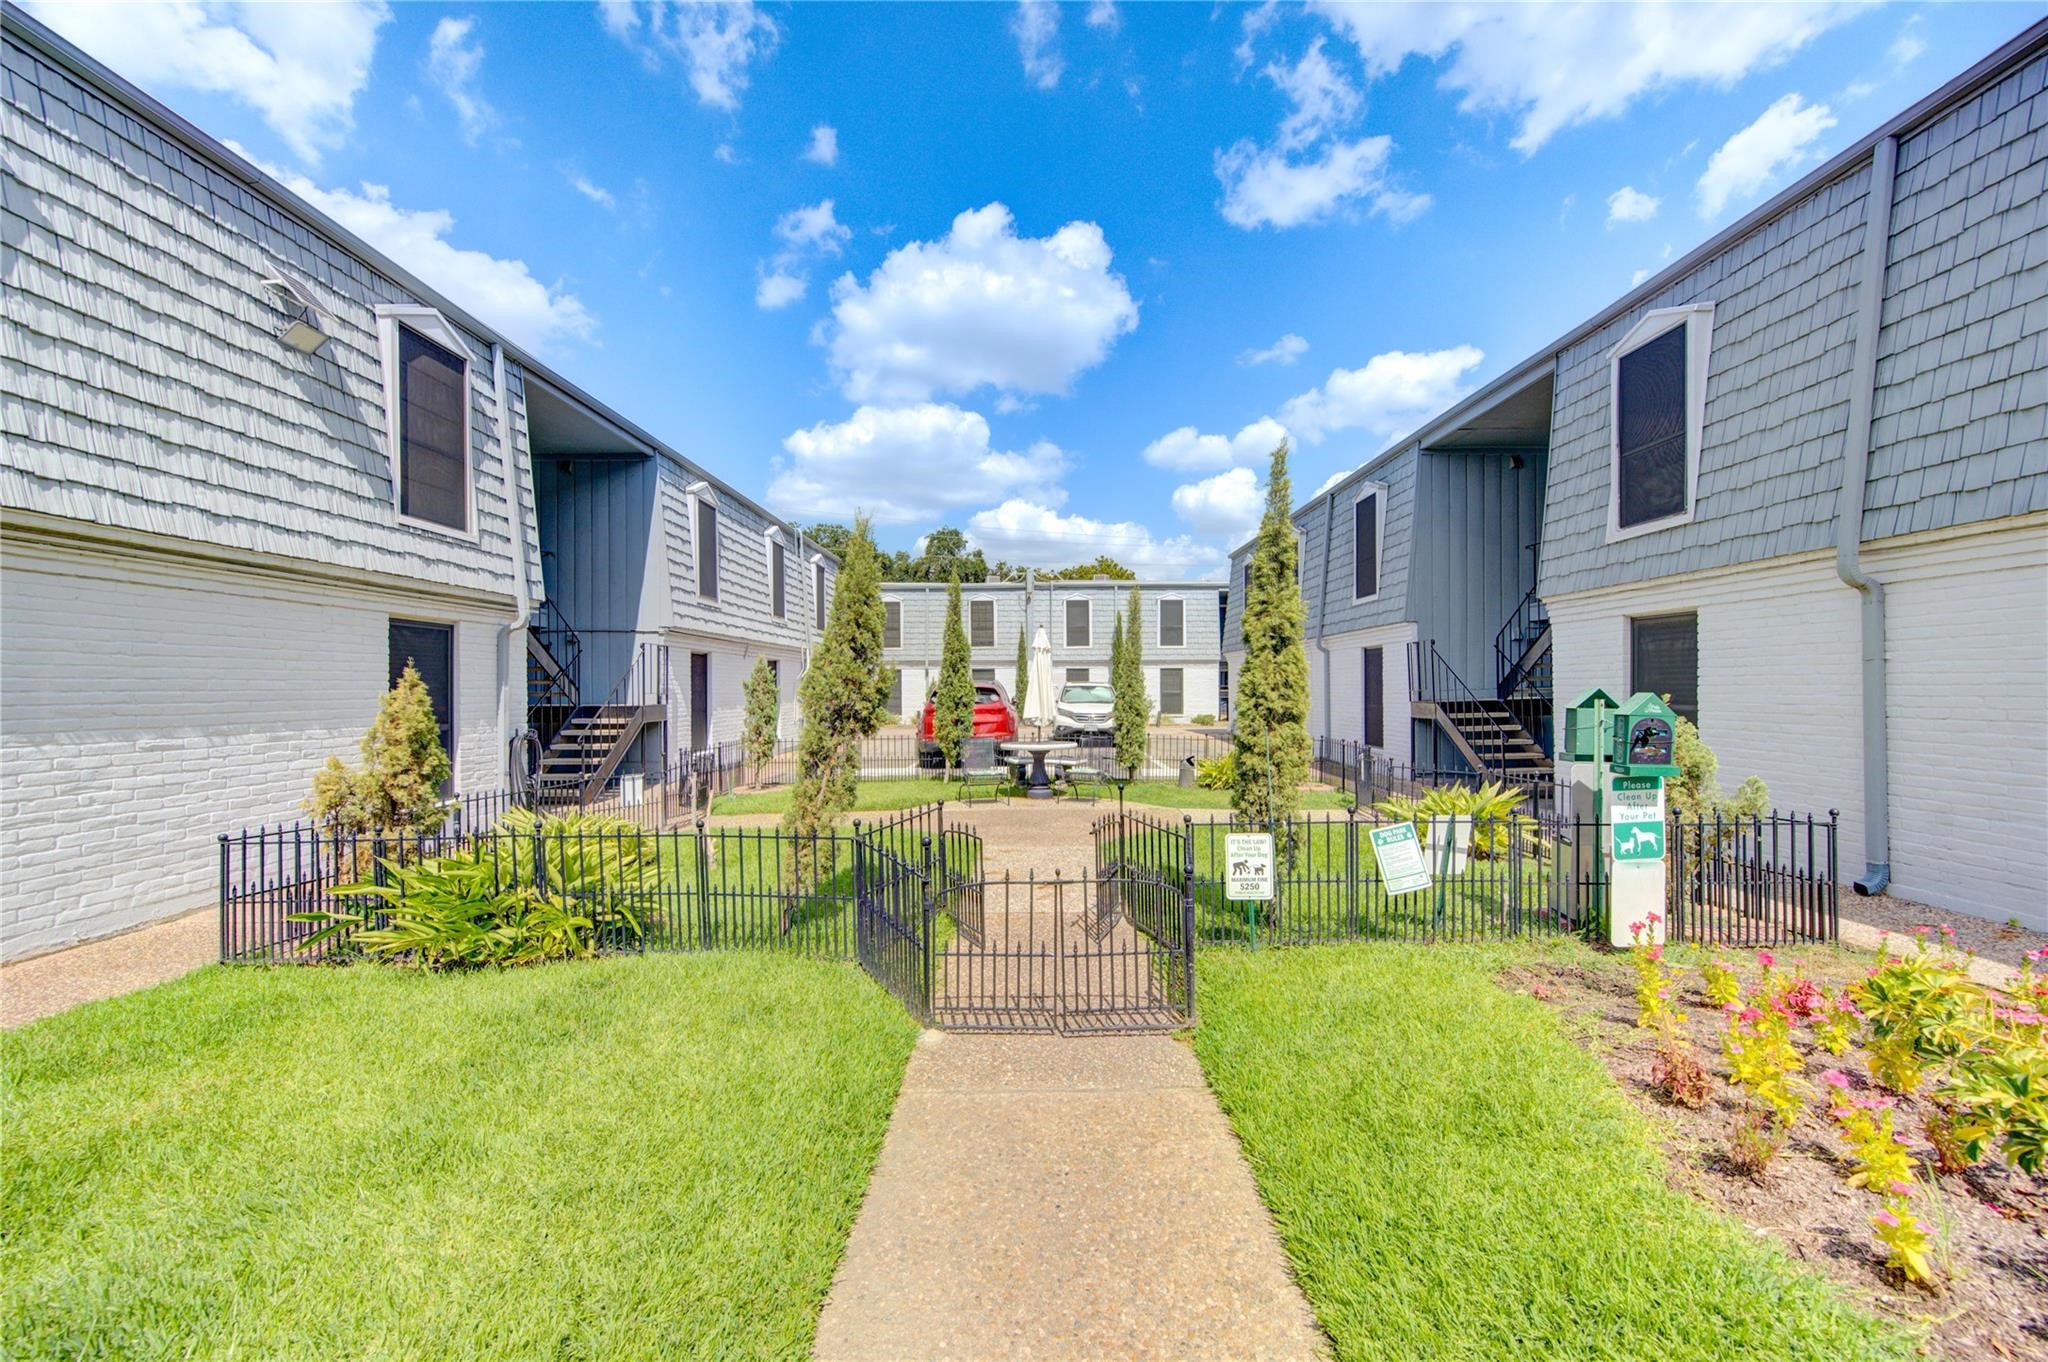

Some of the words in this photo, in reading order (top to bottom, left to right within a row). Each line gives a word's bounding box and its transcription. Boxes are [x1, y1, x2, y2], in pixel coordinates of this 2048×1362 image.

[1623, 781, 1652, 790] Please
[1617, 792, 1641, 801] Clean
[1645, 792, 1658, 801] Up
[1627, 802, 1648, 810] After
[1619, 812, 1639, 820] Your
[1643, 811, 1656, 820] Pet
[1240, 882, 1260, 890] $250
